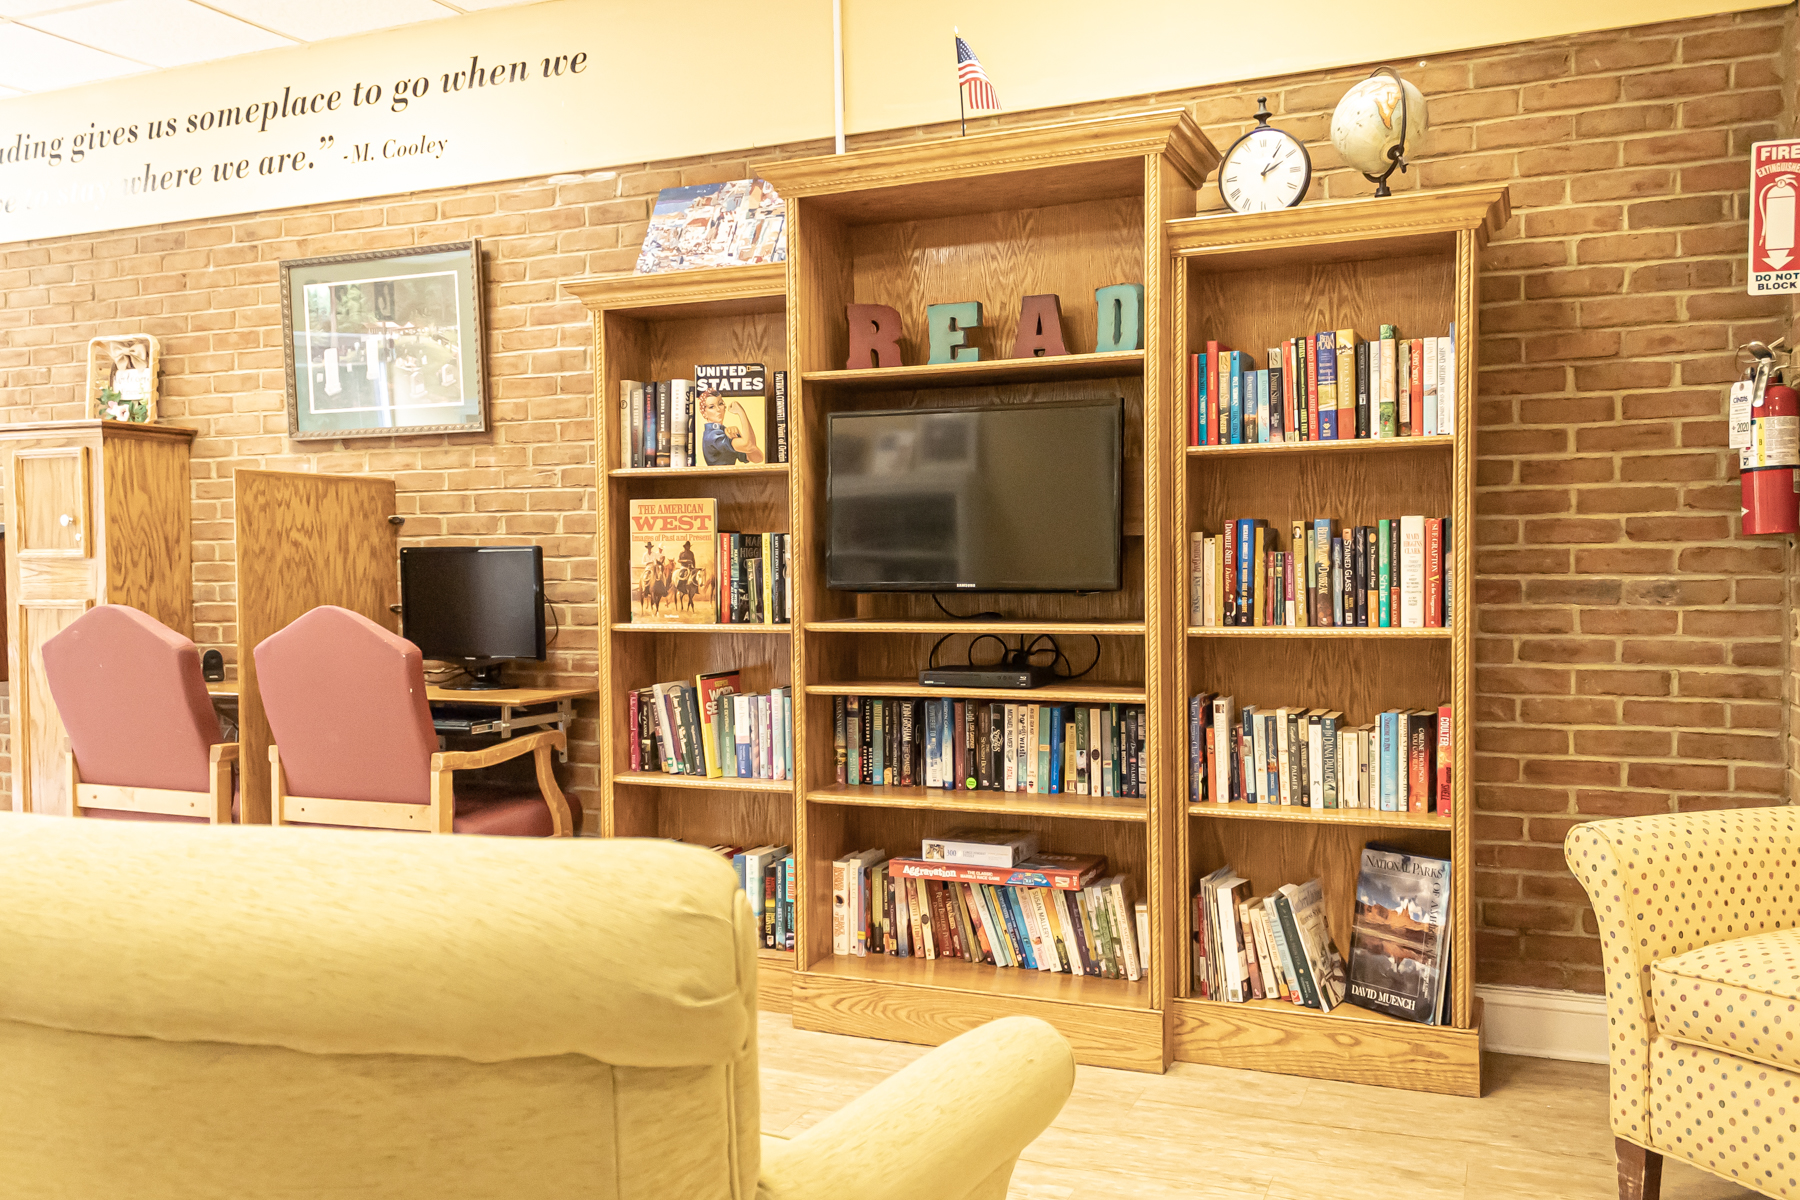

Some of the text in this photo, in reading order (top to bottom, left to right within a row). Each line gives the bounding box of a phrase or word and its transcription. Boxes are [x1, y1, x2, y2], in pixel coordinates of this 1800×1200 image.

[70, 122, 139, 163] gives
[148, 116, 177, 140] us
[186, 86, 342, 133] someplace
[353, 82, 382, 107] to
[390, 77, 430, 113] go
[439, 55, 530, 94] when
[540, 51, 588, 78] we
[1760, 144, 1800, 162] FIRE
[123, 162, 203, 193] where
[211, 159, 250, 182] we
[382, 134, 448, 159] Cooley
[1756, 161, 1800, 179] EXTINGUISHE
[1755, 272, 1800, 282] DO NOT
[1757, 281, 1798, 291] BLOCK
[846, 283, 1145, 369] READ
[1317, 341, 1335, 350] PLAIN
[696, 365, 747, 378] UNITED
[696, 377, 764, 392] STATES
[778, 423, 786, 438] Point
[638, 503, 704, 515] THE AMERICAN
[632, 515, 712, 532] WEST
[1430, 523, 1438, 538] SUE
[632, 533, 713, 543] Images of Past and Present
[1224, 523, 1233, 548] DANIELLE
[1317, 526, 1329, 544] BELVA
[1405, 532, 1420, 540] MARY
[1224, 549, 1234, 565] STEEL
[1404, 547, 1422, 555] CLARK
[1431, 538, 1439, 567] GRAFTON
[1344, 539, 1353, 592] STAINED GLASS
[1379, 574, 1388, 603] Schuller
[902, 703, 912, 717] JOHN
[902, 717, 912, 742] GRISHAM
[1439, 716, 1450, 747] COULTER
[1006, 729, 1014, 749] PALMER
[1190, 741, 1198, 759] Clark
[1323, 737, 1336, 783] DIANA PALMER
[1440, 784, 1450, 801] SHELL
[946, 849, 957, 858] 300
[902, 864, 958, 878] Aggravation
[1365, 854, 1444, 879] NATIONAL PARKS
[1432, 881, 1441, 898] OF
[1032, 890, 1050, 939] SUSAN MALLERY
[1351, 984, 1416, 1012] DAVID MUENCH
